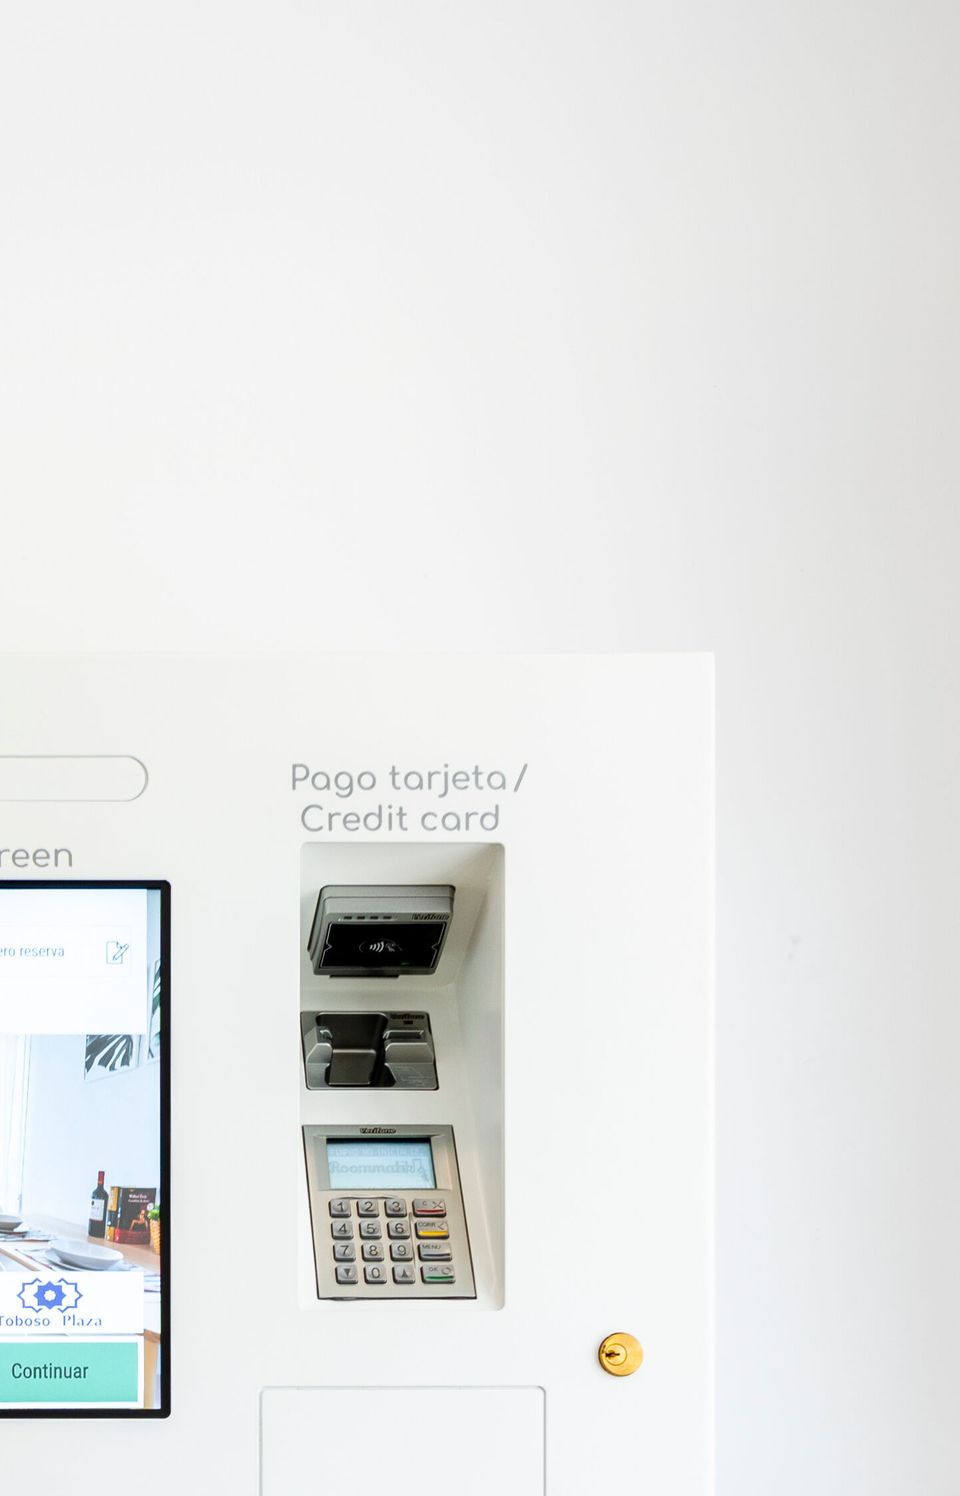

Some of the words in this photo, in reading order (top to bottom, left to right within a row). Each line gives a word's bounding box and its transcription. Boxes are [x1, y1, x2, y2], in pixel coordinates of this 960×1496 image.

[291, 763, 377, 799] Pago
[388, 763, 507, 799] tarjeta
[513, 762, 529, 793] /
[300, 803, 409, 833] Credit
[420, 803, 500, 832] card
[19, 947, 65, 957] reserva
[337, 1201, 345, 1212] 1
[364, 1201, 373, 1212] 2
[391, 1201, 401, 1212] 3
[338, 1223, 348, 1234] 4
[366, 1223, 376, 1234] 5
[394, 1223, 405, 1234] 6
[340, 1245, 350, 1256] 7
[368, 1245, 378, 1256] 8
[396, 1245, 407, 1256] 9
[371, 1268, 381, 1279] 0
[60, 1313, 102, 1327] Plaza
[11, 1362, 89, 1380] Continuar
